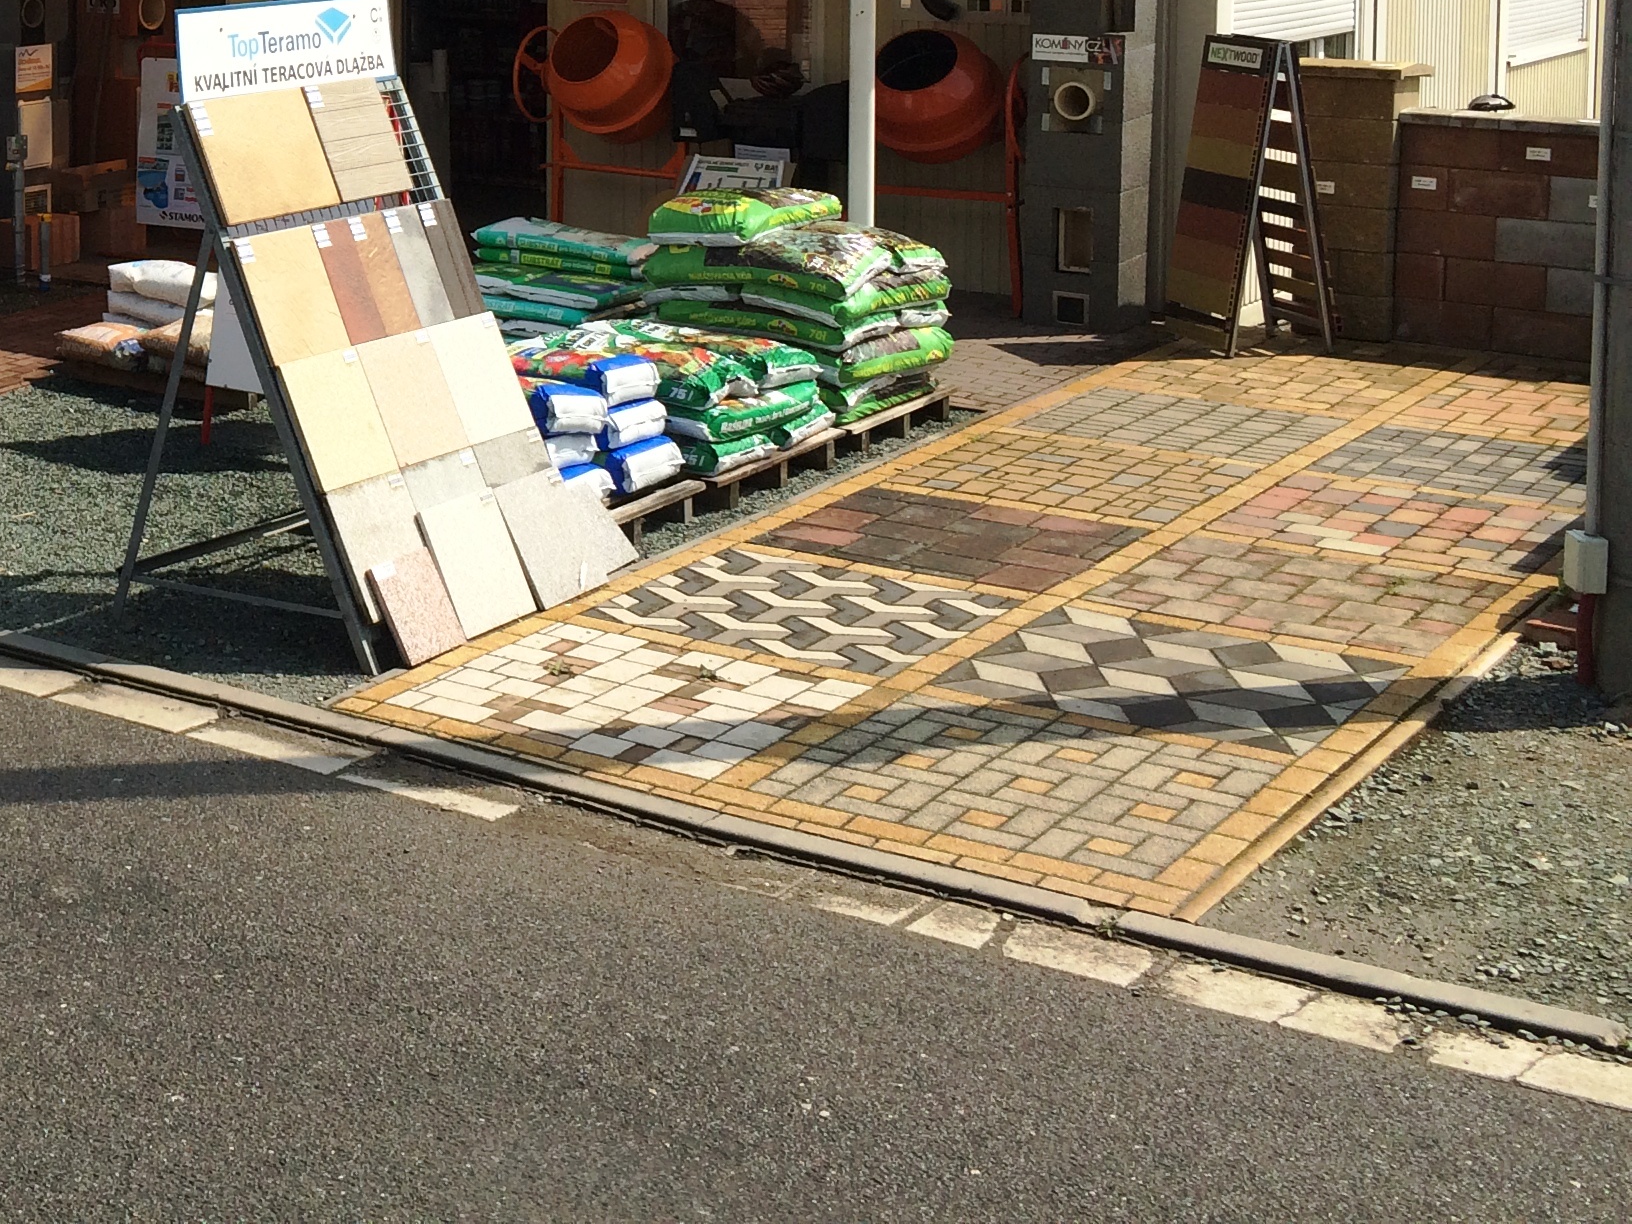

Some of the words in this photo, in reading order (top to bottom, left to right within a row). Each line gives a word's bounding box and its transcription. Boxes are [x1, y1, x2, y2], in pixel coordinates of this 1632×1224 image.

[227, 31, 322, 60] TopTeramo
[1210, 46, 1258, 64] NEXTWOOD
[194, 63, 257, 92] KVALITNÍ
[261, 55, 334, 84] TERACOVÁ
[336, 52, 385, 75] DLAŽBA
